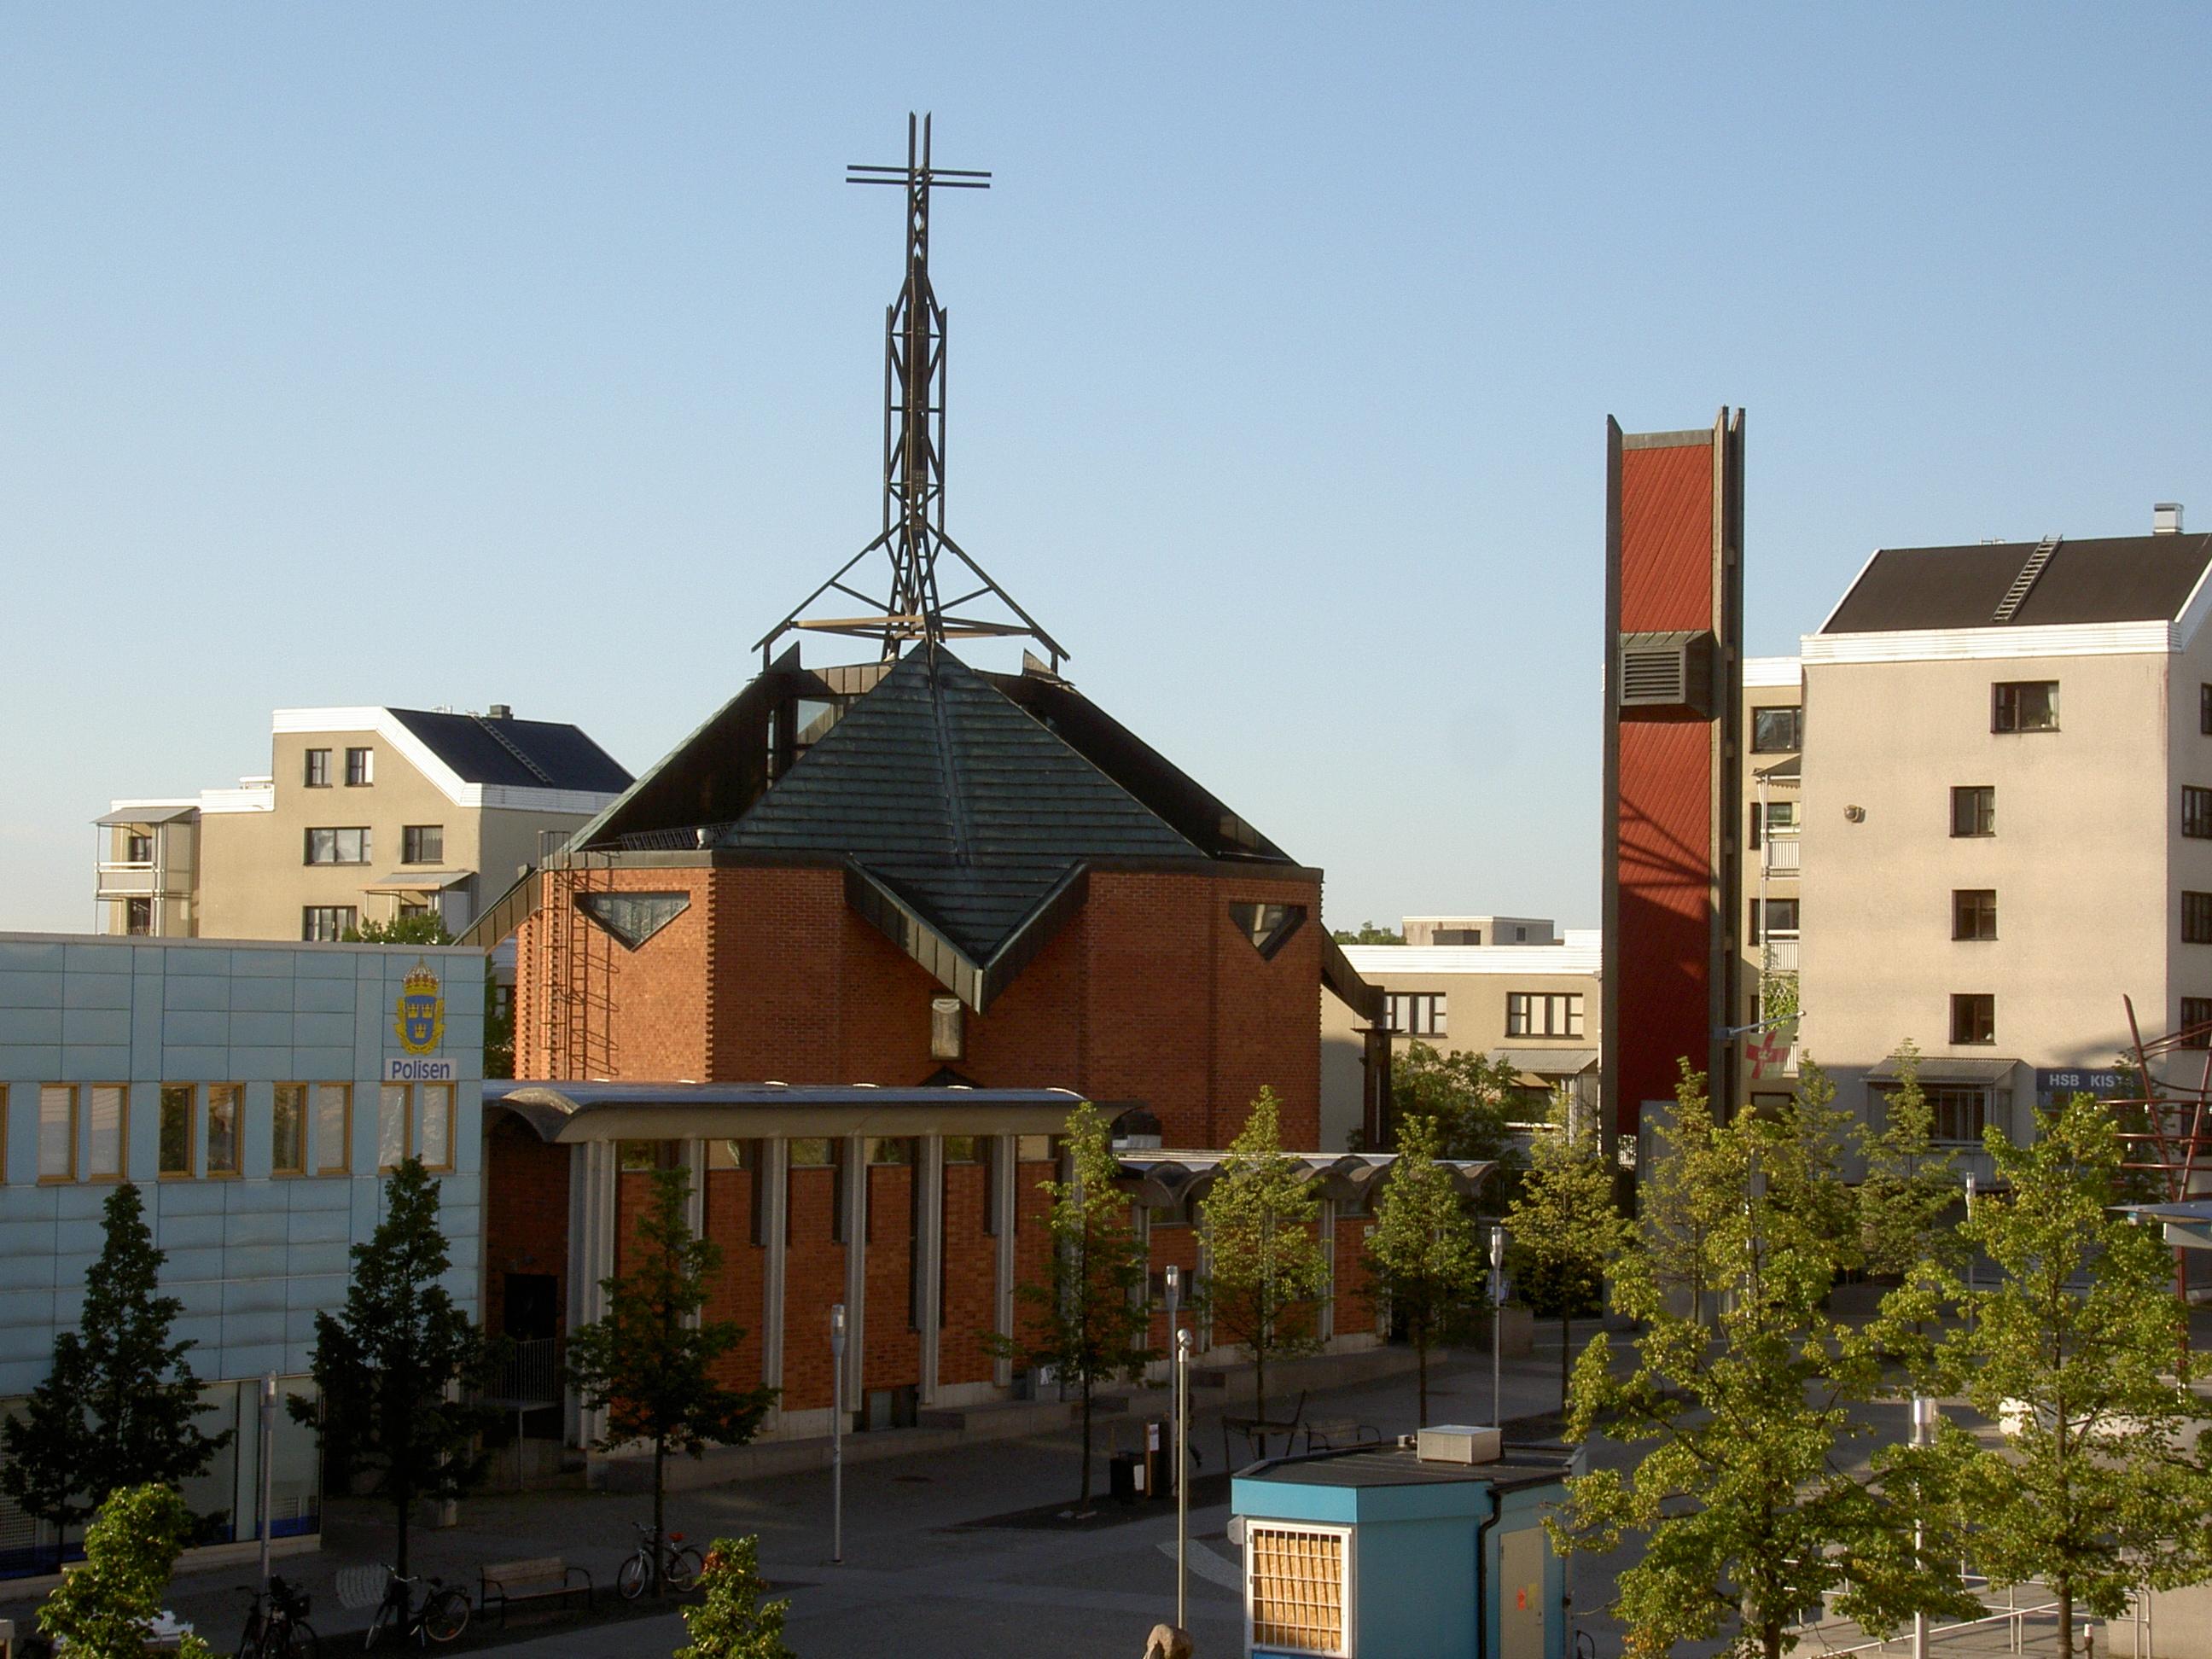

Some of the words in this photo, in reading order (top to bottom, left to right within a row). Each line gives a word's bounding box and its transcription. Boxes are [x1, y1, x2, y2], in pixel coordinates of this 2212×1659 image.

[392, 1060, 451, 1080] Polisen
[2049, 1074, 2080, 1086] HSB
[2091, 1074, 2134, 1088] KIS
